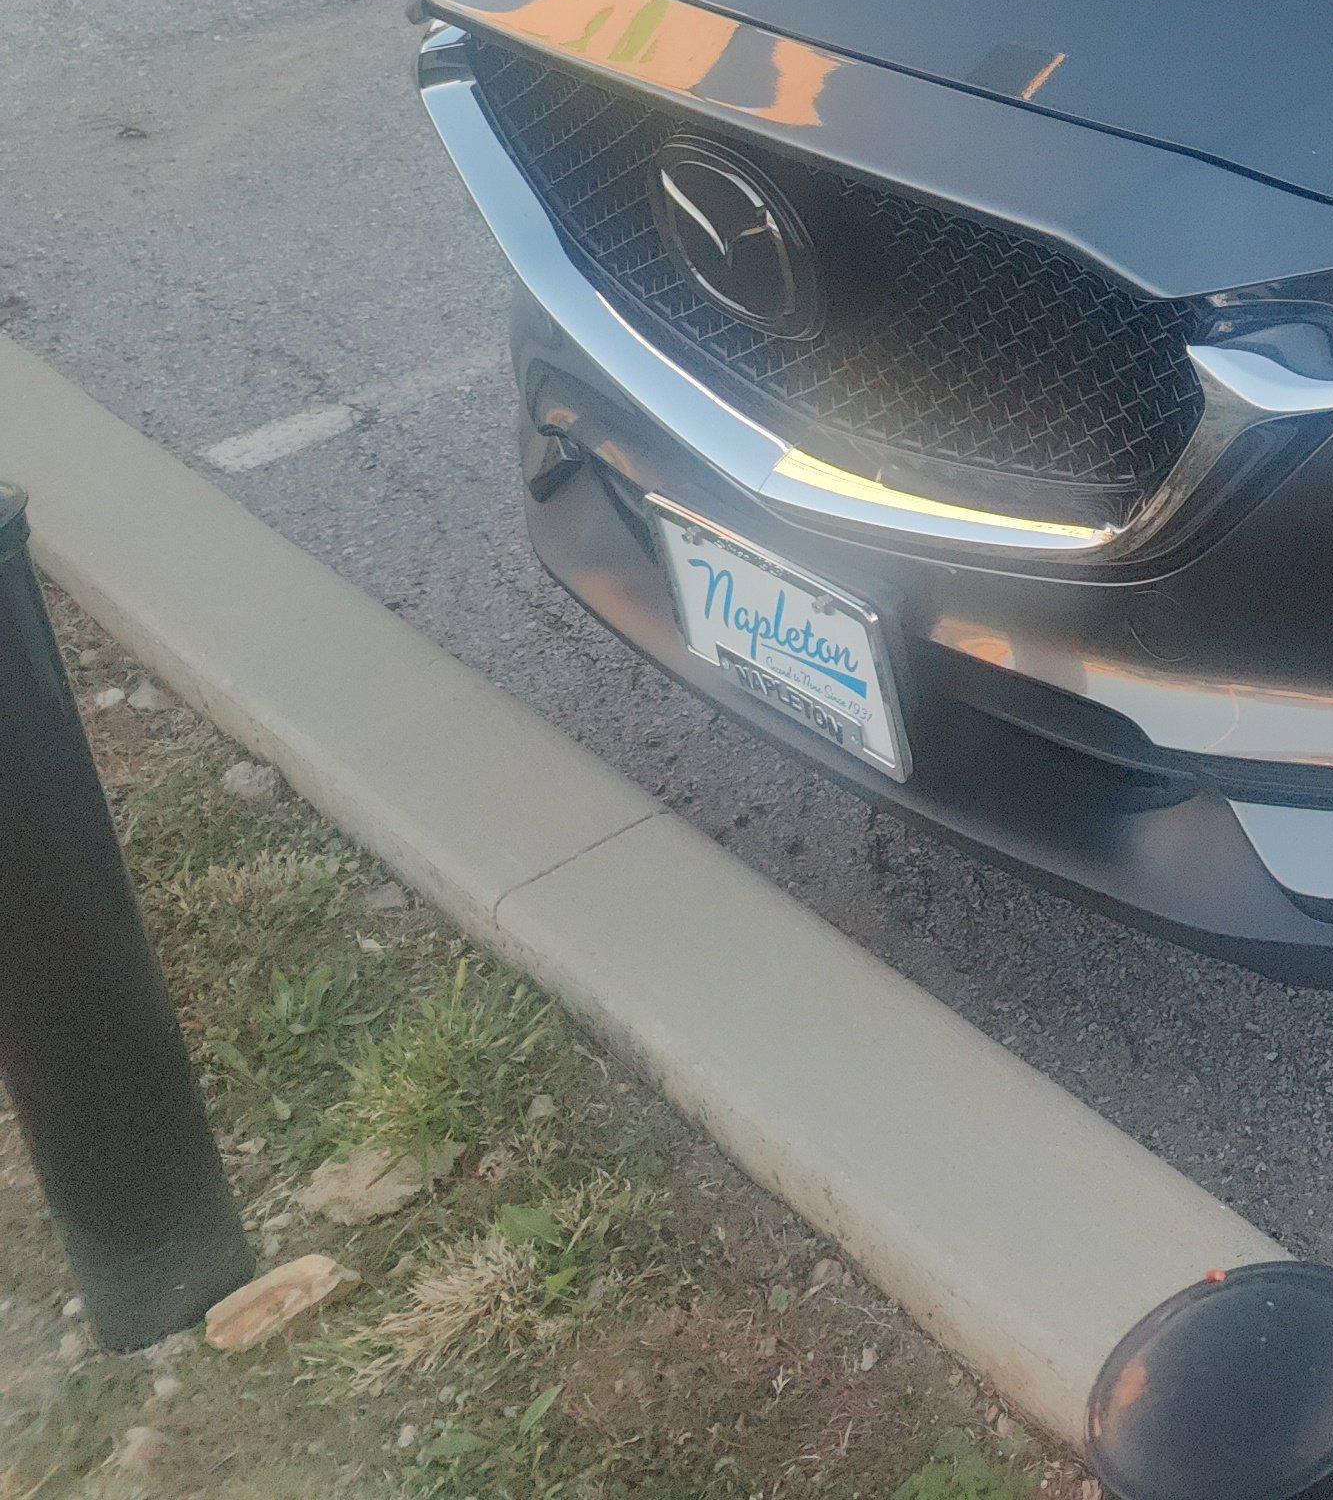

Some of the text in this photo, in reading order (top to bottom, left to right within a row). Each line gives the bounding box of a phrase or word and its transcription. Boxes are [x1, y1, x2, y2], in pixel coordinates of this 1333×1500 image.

[688, 558, 859, 673] Napleton
[735, 665, 844, 745] NAPLETON
[765, 656, 792, 678] Second
[824, 685, 847, 707] Since
[847, 699, 873, 722] 1931
